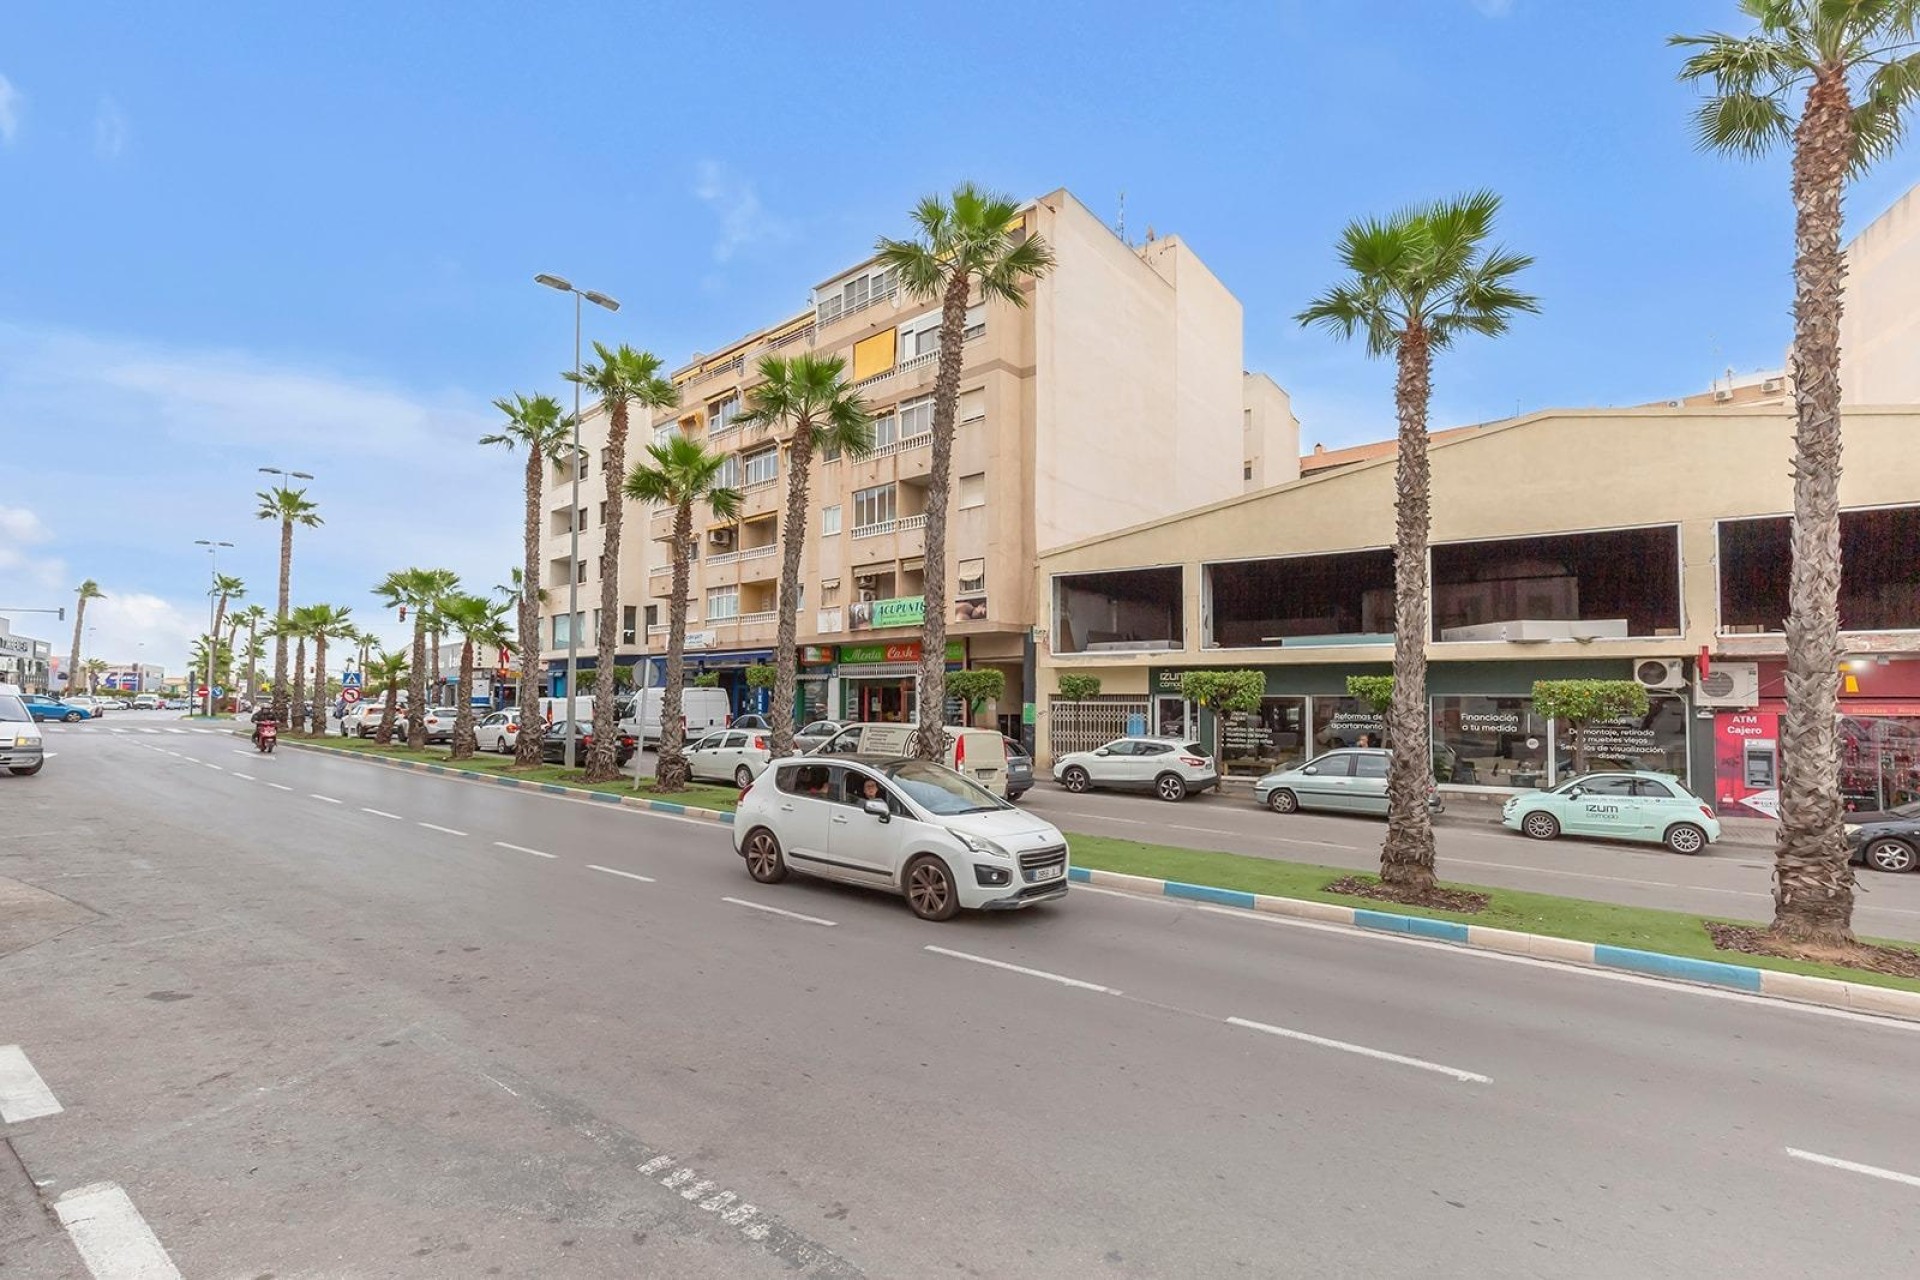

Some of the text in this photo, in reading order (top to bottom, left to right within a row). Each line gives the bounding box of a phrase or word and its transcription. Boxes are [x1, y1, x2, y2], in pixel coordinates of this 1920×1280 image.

[887, 646, 913, 659] Cash
[1334, 712, 1371, 720] Reformas
[1461, 713, 1519, 722] Financiación
[1732, 715, 1758, 724] ATM
[1470, 724, 1480, 732] tu
[1481, 724, 1518, 733] medida
[1620, 728, 1655, 737] retirada
[1727, 725, 1763, 735] Cajero
[1596, 744, 1609, 752] de
